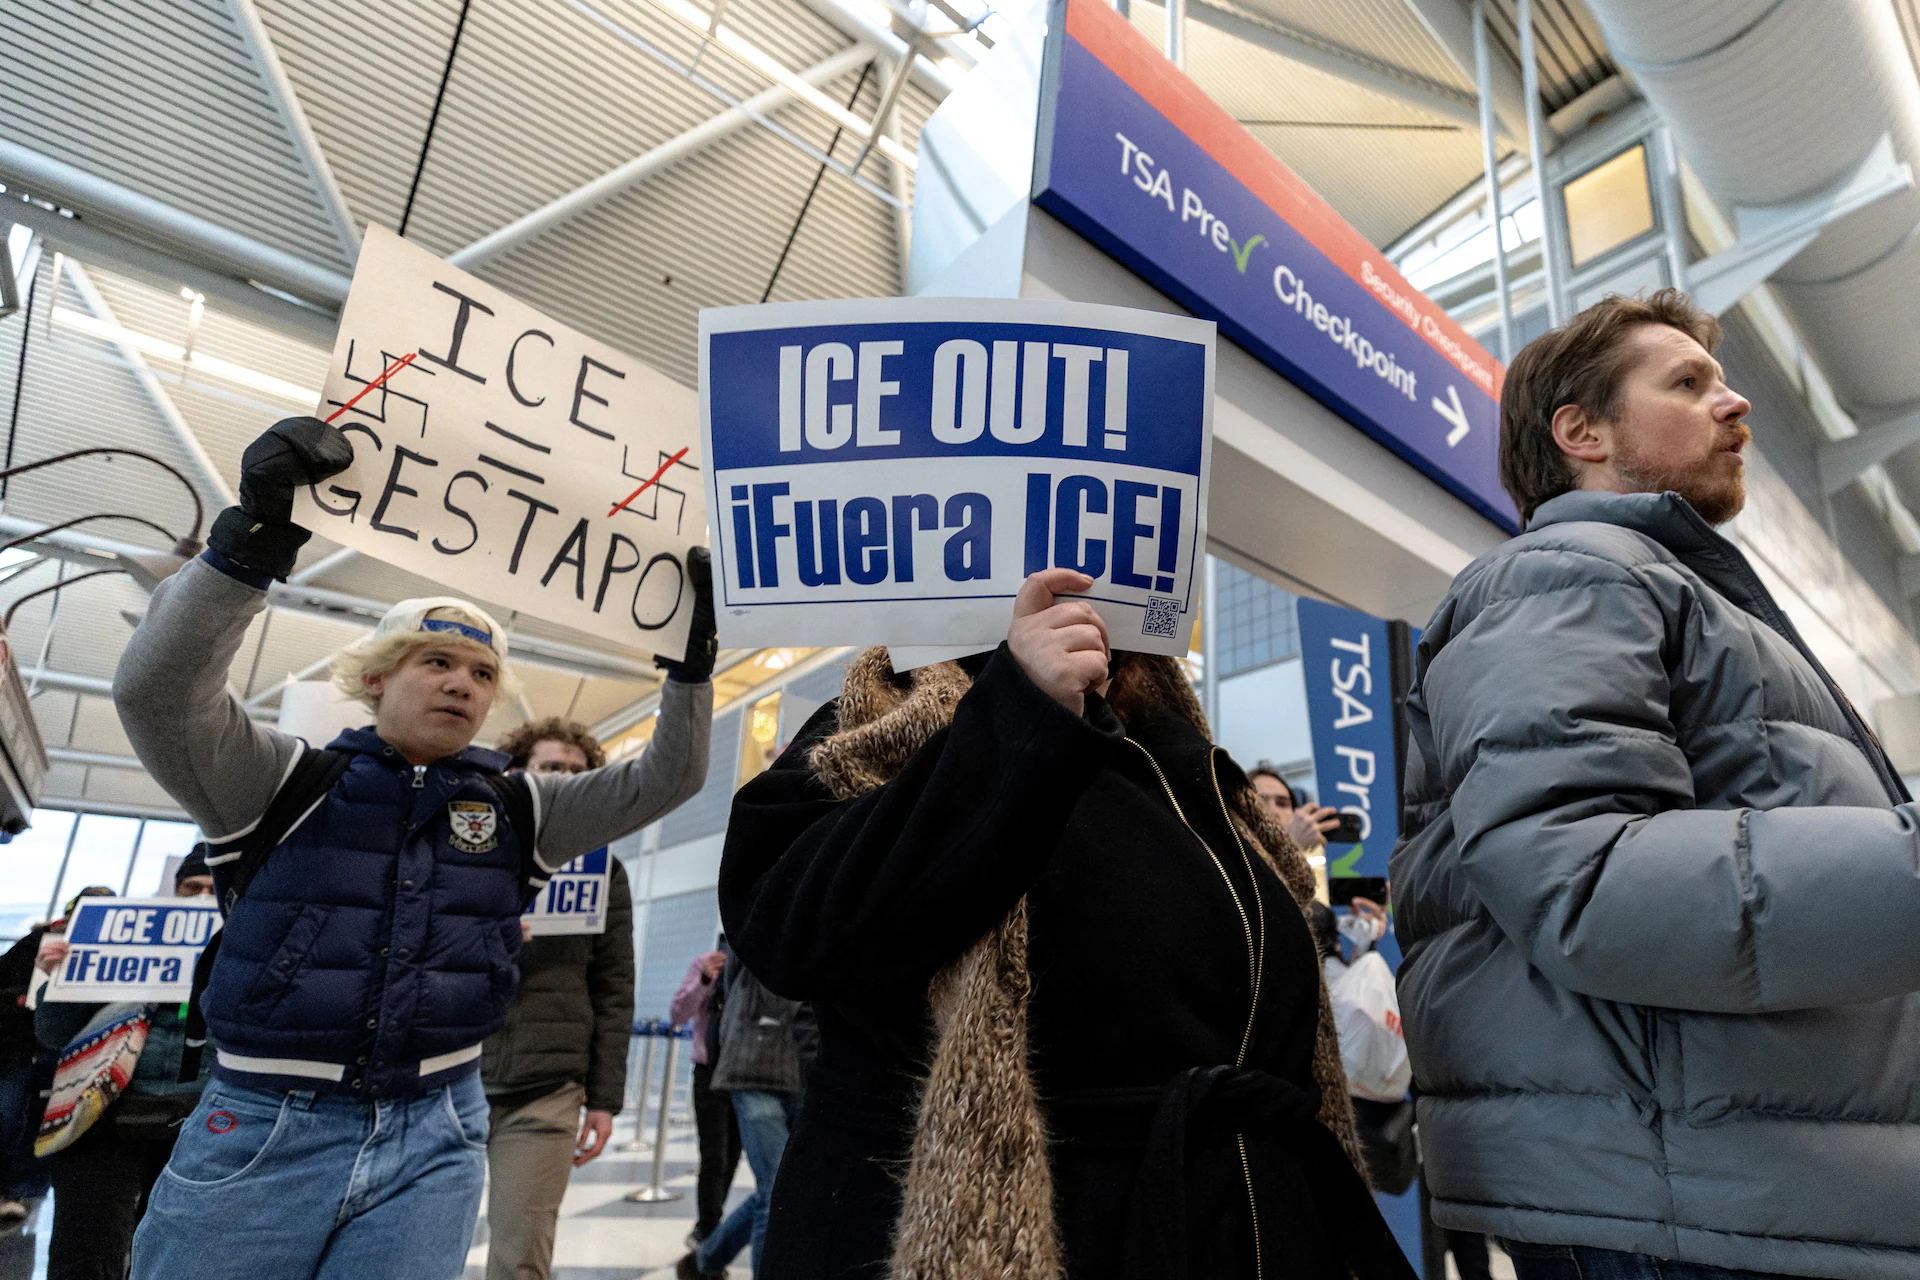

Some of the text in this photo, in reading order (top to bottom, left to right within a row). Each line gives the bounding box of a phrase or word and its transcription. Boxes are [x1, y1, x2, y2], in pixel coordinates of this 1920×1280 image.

[1115, 132, 1417, 401] TSA Pre Checkpoint
[1360, 260, 1494, 392] Security Checkpoint
[418, 281, 626, 442] ICE
[779, 339, 1130, 453] ICE OUT!
[308, 422, 684, 631] GESTAPO
[1023, 473, 1182, 594] ICE!
[1330, 632, 1374, 730] TSA
[98, 908, 158, 944] ICE
[546, 880, 600, 914] ICE!
